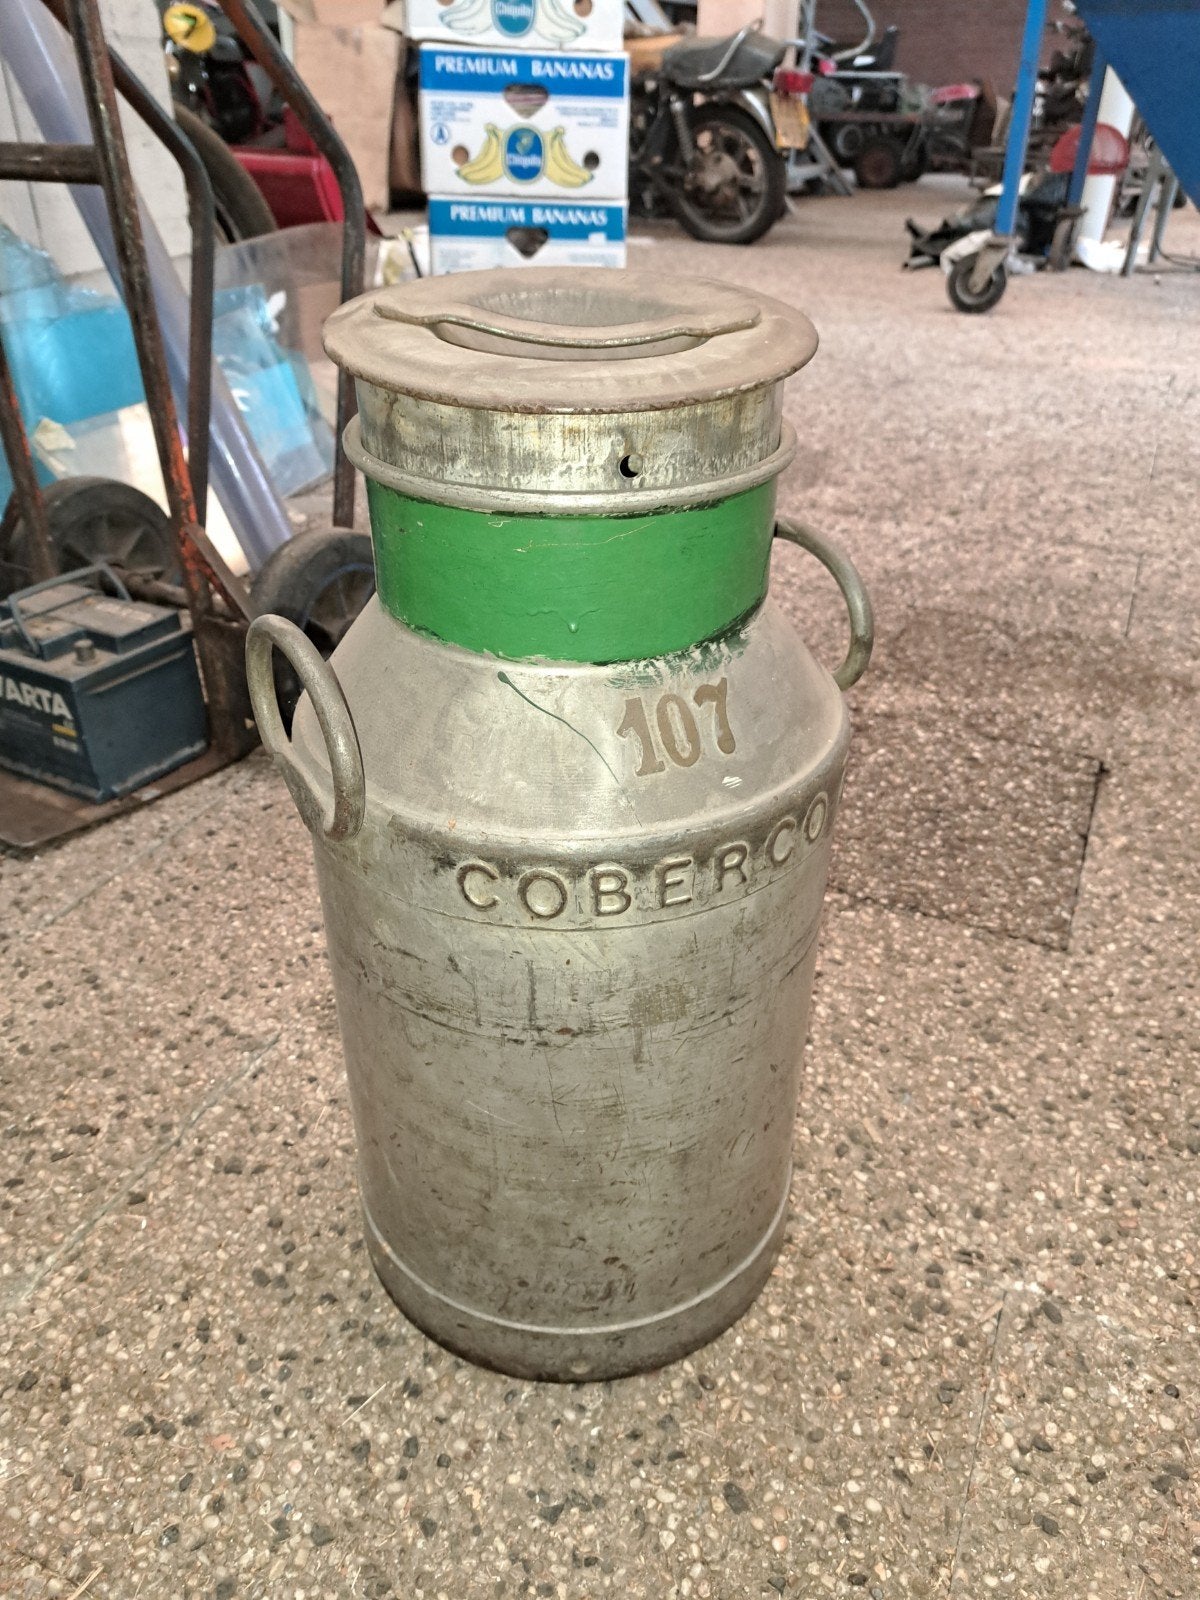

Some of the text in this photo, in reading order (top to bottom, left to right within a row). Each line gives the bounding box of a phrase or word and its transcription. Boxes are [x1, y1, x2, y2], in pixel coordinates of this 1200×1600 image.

[434, 55, 615, 80] PREMIUM BANANAS
[450, 204, 608, 226] PREMIUM BANANAS
[0, 674, 75, 720] ARTA
[616, 676, 737, 777] 107
[456, 791, 829, 920] COBERCO
